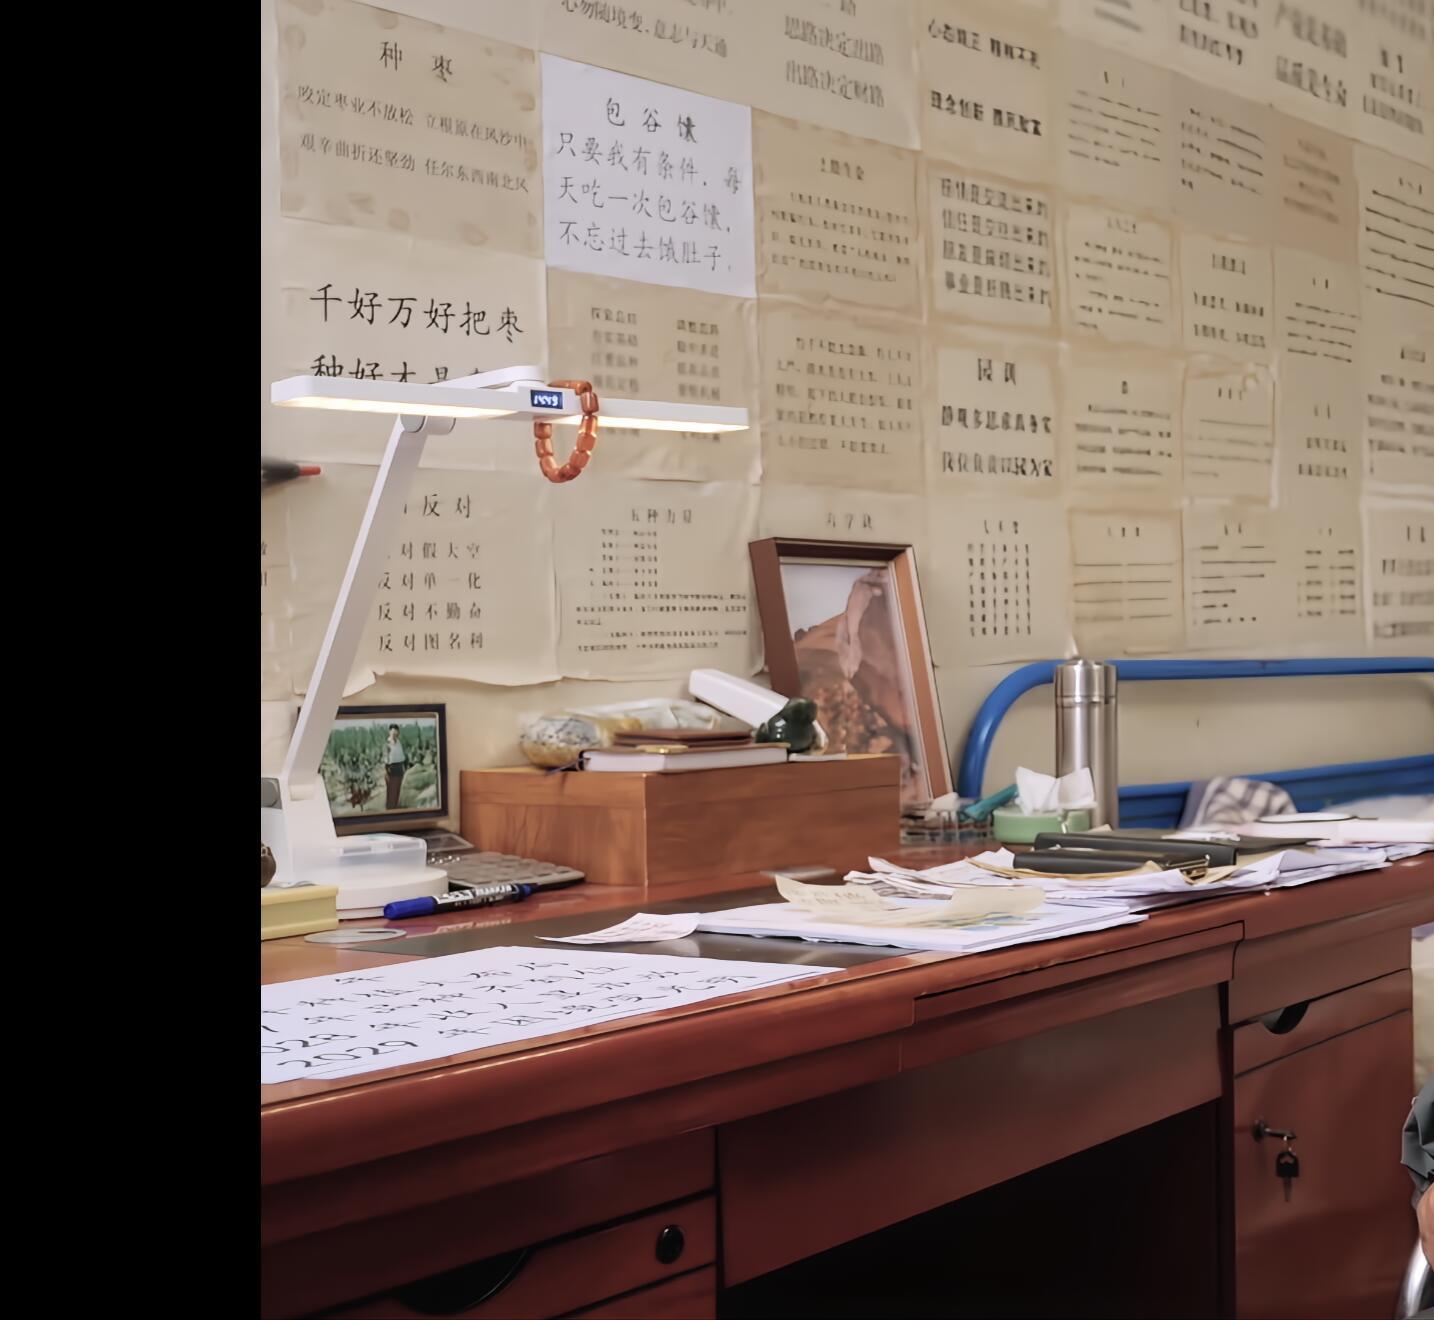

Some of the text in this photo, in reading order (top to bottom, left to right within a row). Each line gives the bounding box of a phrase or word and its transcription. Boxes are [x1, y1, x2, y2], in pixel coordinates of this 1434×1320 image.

[379, 41, 454, 83] 种枣
[310, 284, 524, 344] 千好万好把枣
[404, 493, 470, 519] 反对
[387, 541, 481, 560] 对假大空
[378, 602, 482, 621] 反对不勤奋
[379, 632, 483, 652] 反对图名利
